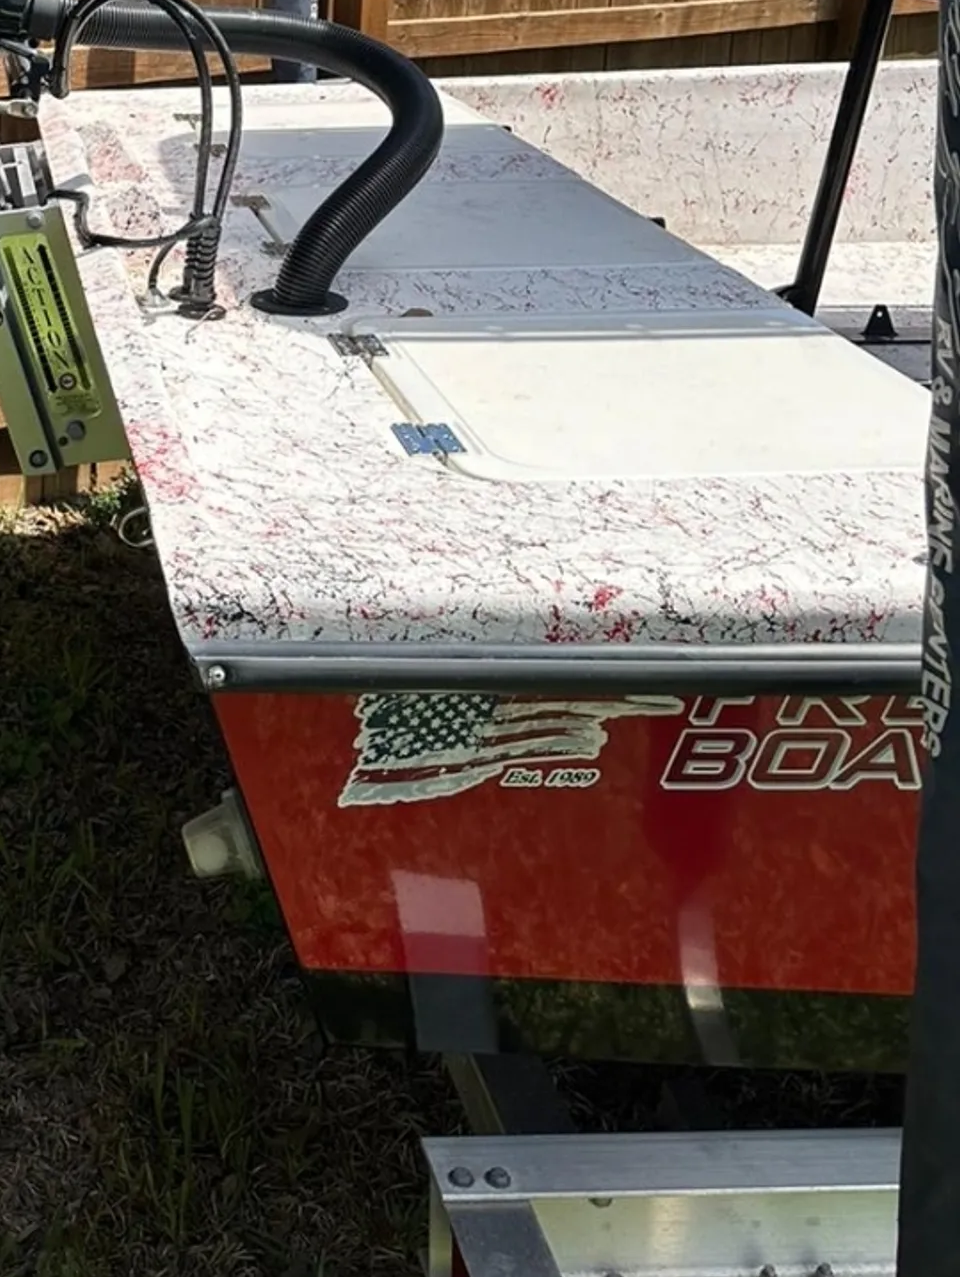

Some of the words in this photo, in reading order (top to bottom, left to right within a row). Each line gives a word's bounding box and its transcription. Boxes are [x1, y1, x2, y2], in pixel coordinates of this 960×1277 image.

[936, 316, 954, 379] RV
[931, 375, 953, 406] &
[927, 413, 954, 574] MARINE
[545, 768, 600, 788] 1989
